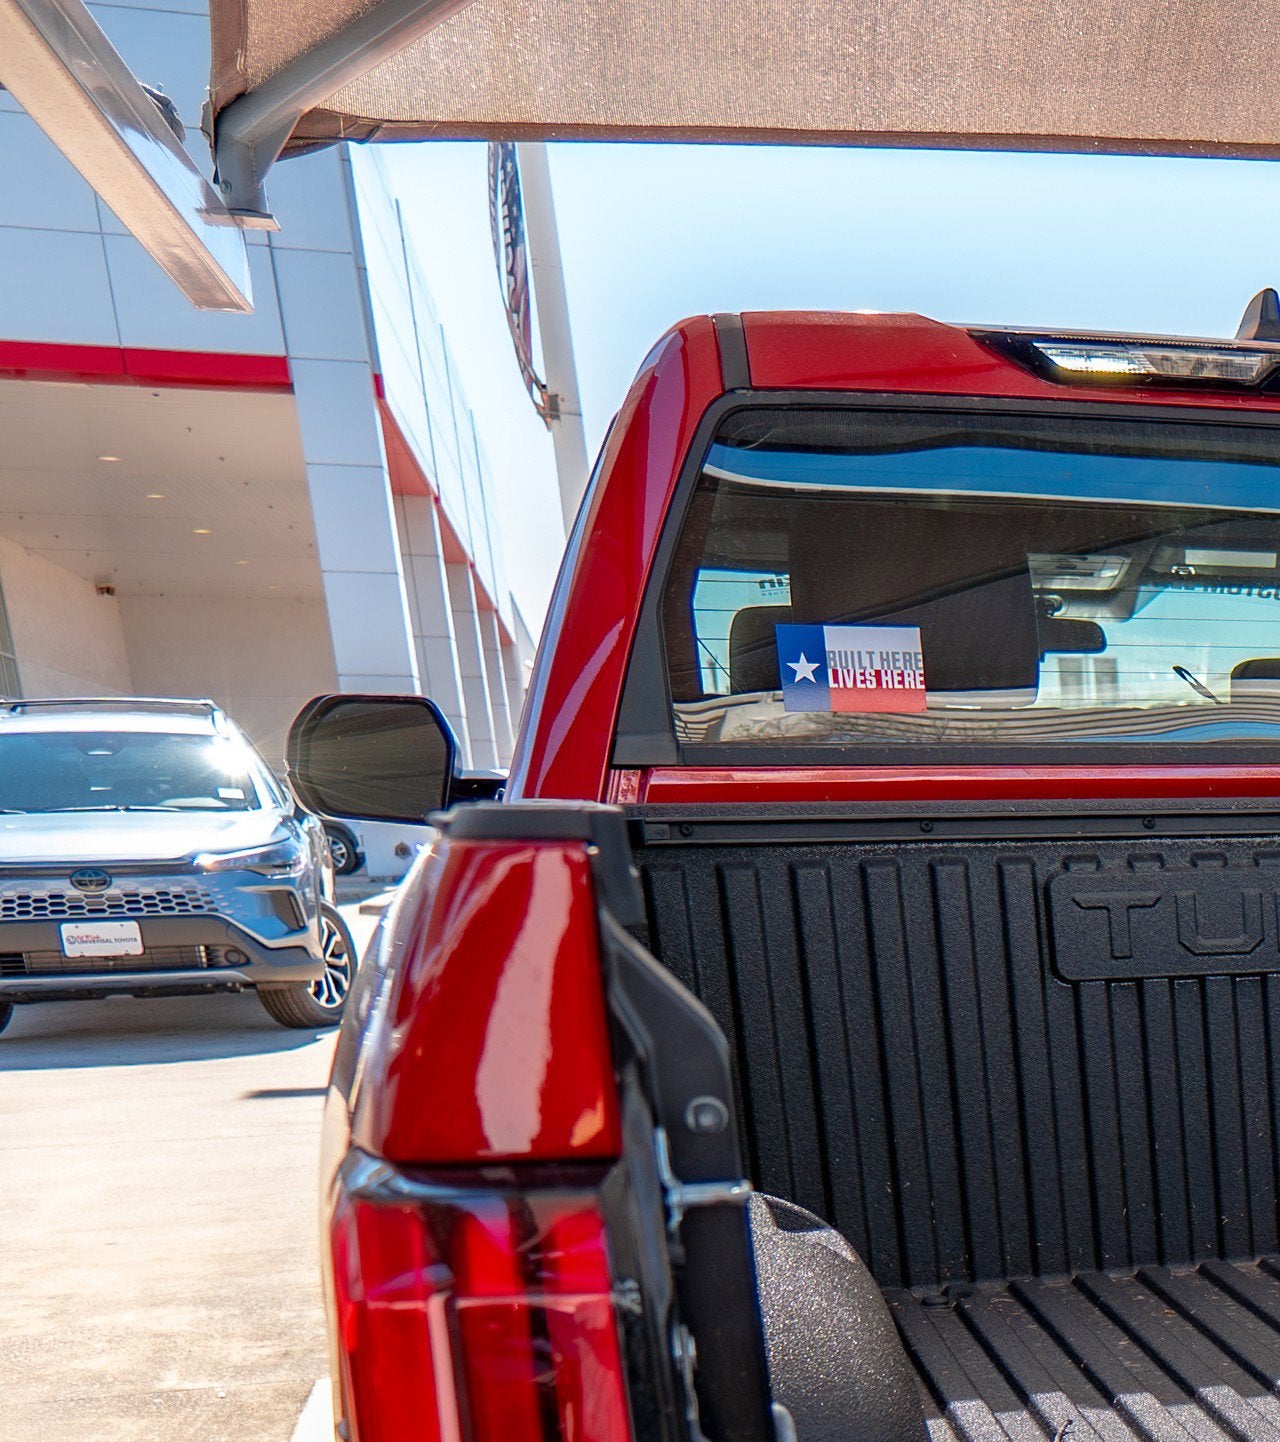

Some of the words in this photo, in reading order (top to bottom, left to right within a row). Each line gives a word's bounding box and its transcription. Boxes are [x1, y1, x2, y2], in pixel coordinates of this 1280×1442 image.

[826, 650, 875, 670] BUILT
[880, 651, 923, 671] HERE
[828, 669, 877, 689] LIVES
[881, 670, 925, 689] HERE
